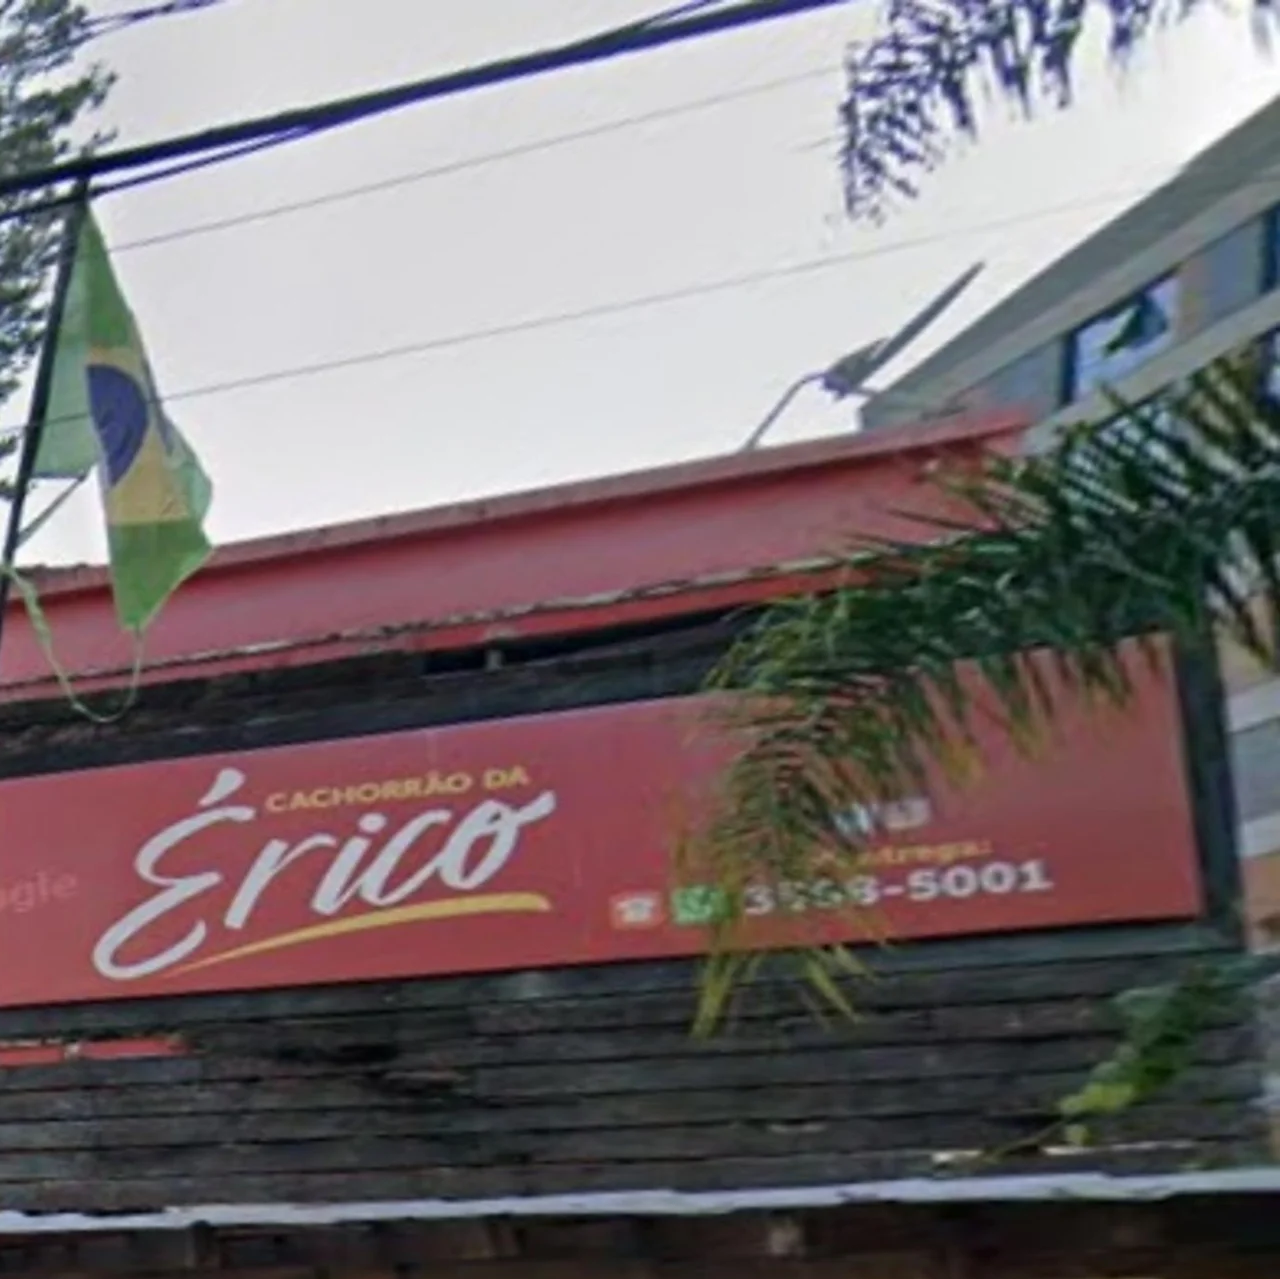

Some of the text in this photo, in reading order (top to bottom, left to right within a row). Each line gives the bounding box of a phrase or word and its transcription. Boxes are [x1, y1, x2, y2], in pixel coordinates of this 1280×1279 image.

[265, 765, 531, 813] CACHORRÃO DA
[92, 767, 557, 981] Érico
